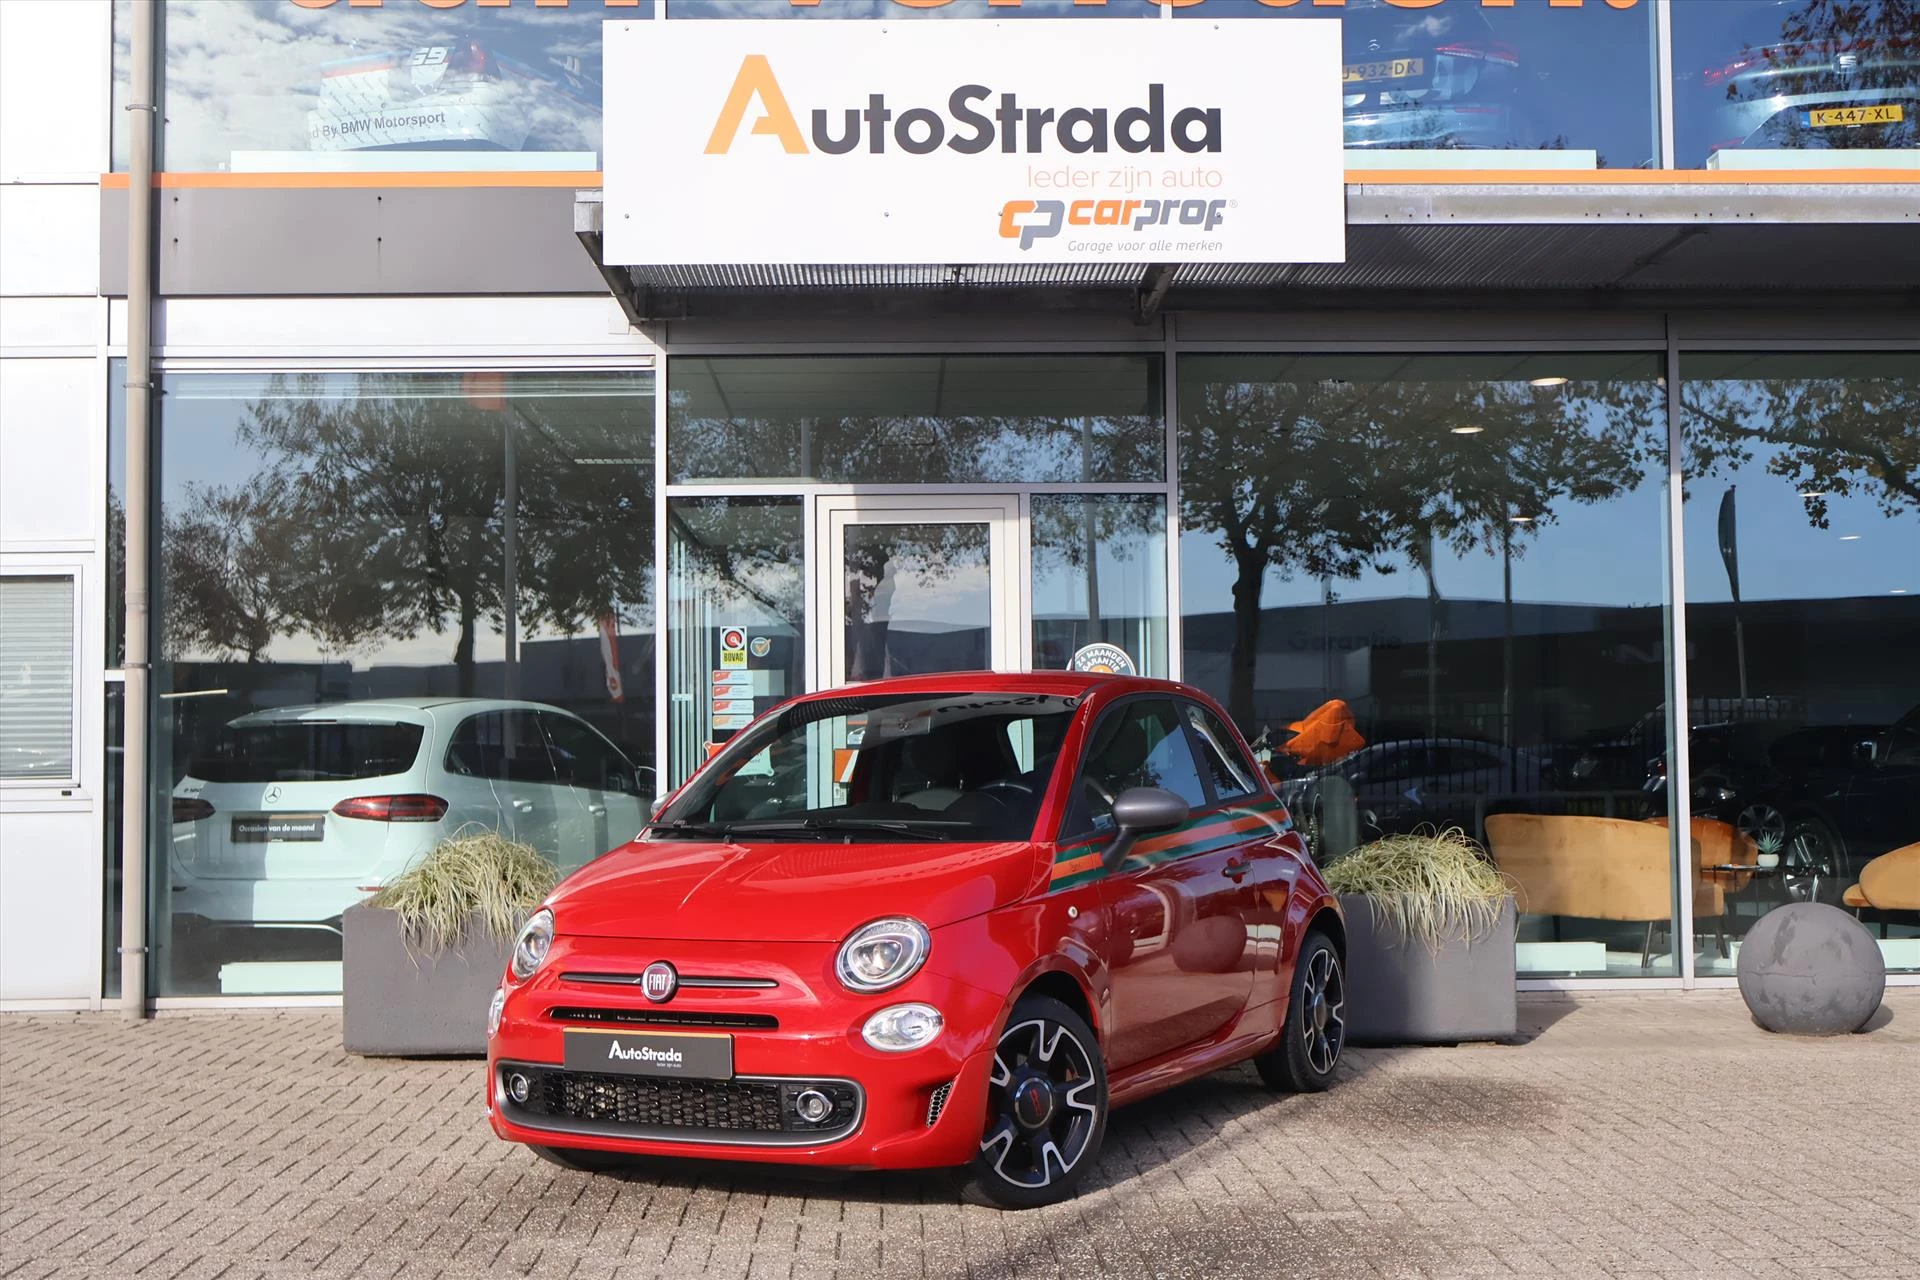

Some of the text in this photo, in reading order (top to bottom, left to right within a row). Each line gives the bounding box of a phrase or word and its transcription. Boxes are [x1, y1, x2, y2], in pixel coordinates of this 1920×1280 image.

[703, 54, 1222, 155] AutoStrada
[322, 125, 338, 138] By
[341, 117, 372, 134] BMW
[374, 111, 446, 130] Motorsport
[1816, 108, 1895, 124] K-447-XL
[1028, 165, 1222, 193] Ieder zijn auto
[1068, 240, 1223, 254] Garage voor alle merken
[723, 652, 744, 662] BOVAG
[1082, 657, 1120, 672] GARANTIE
[1086, 649, 1127, 668] MAANDEN
[239, 824, 268, 832] Occasion
[282, 824, 290, 832] de
[291, 823, 315, 832] maand
[649, 973, 667, 991] FIAT
[608, 1040, 682, 1062] AutoStrada
